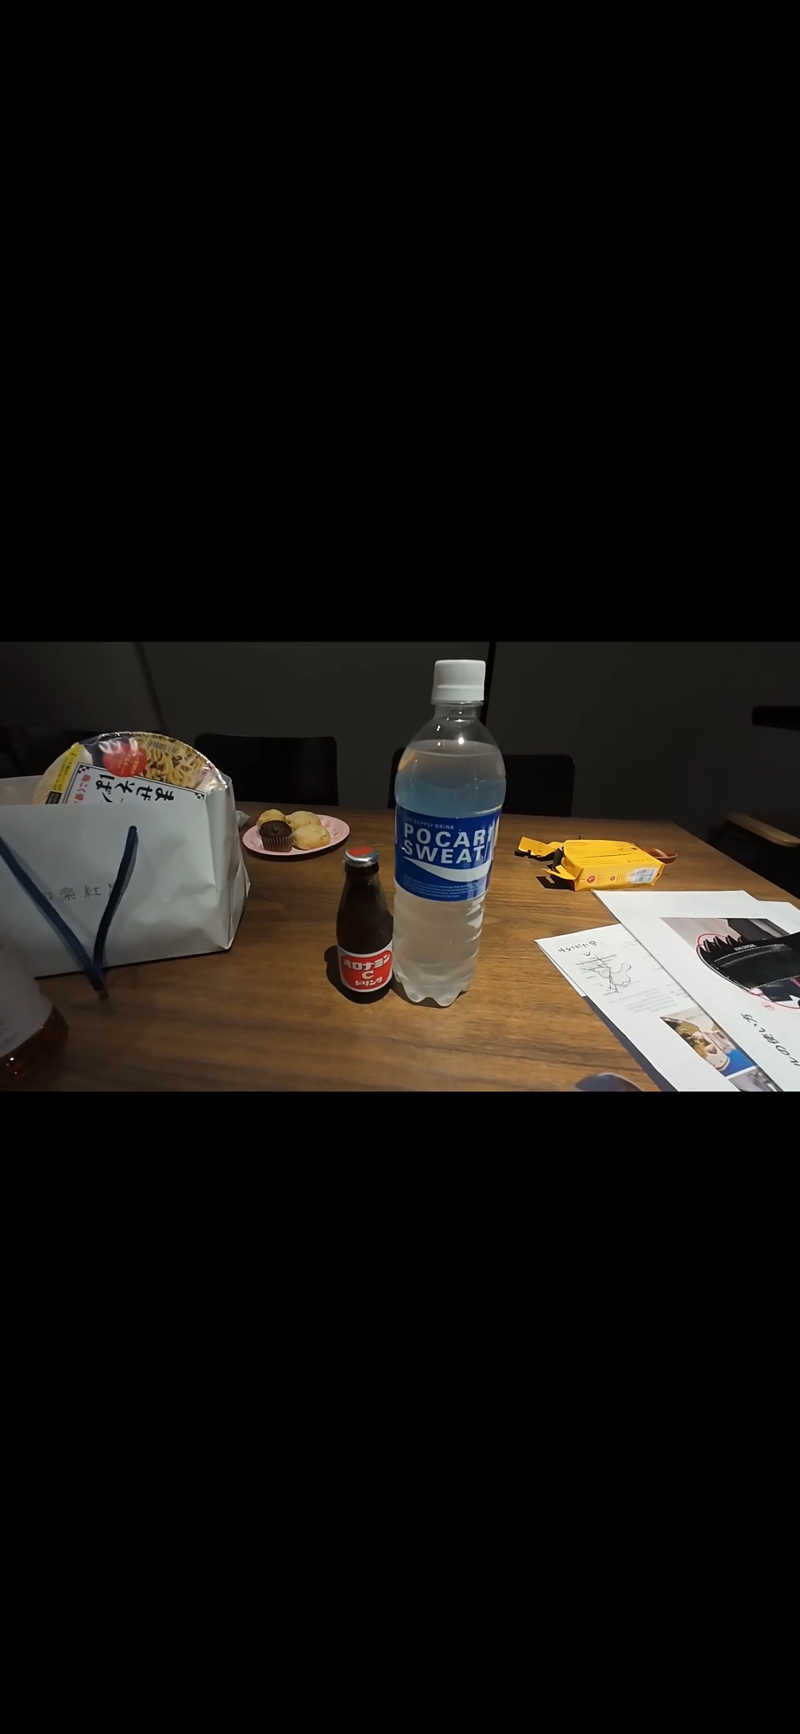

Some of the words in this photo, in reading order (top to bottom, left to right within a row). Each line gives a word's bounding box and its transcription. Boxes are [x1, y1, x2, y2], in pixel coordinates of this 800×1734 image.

[96, 774, 175, 801] まぜそば
[402, 840, 485, 864] SWEAT
[361, 970, 374, 980] C
